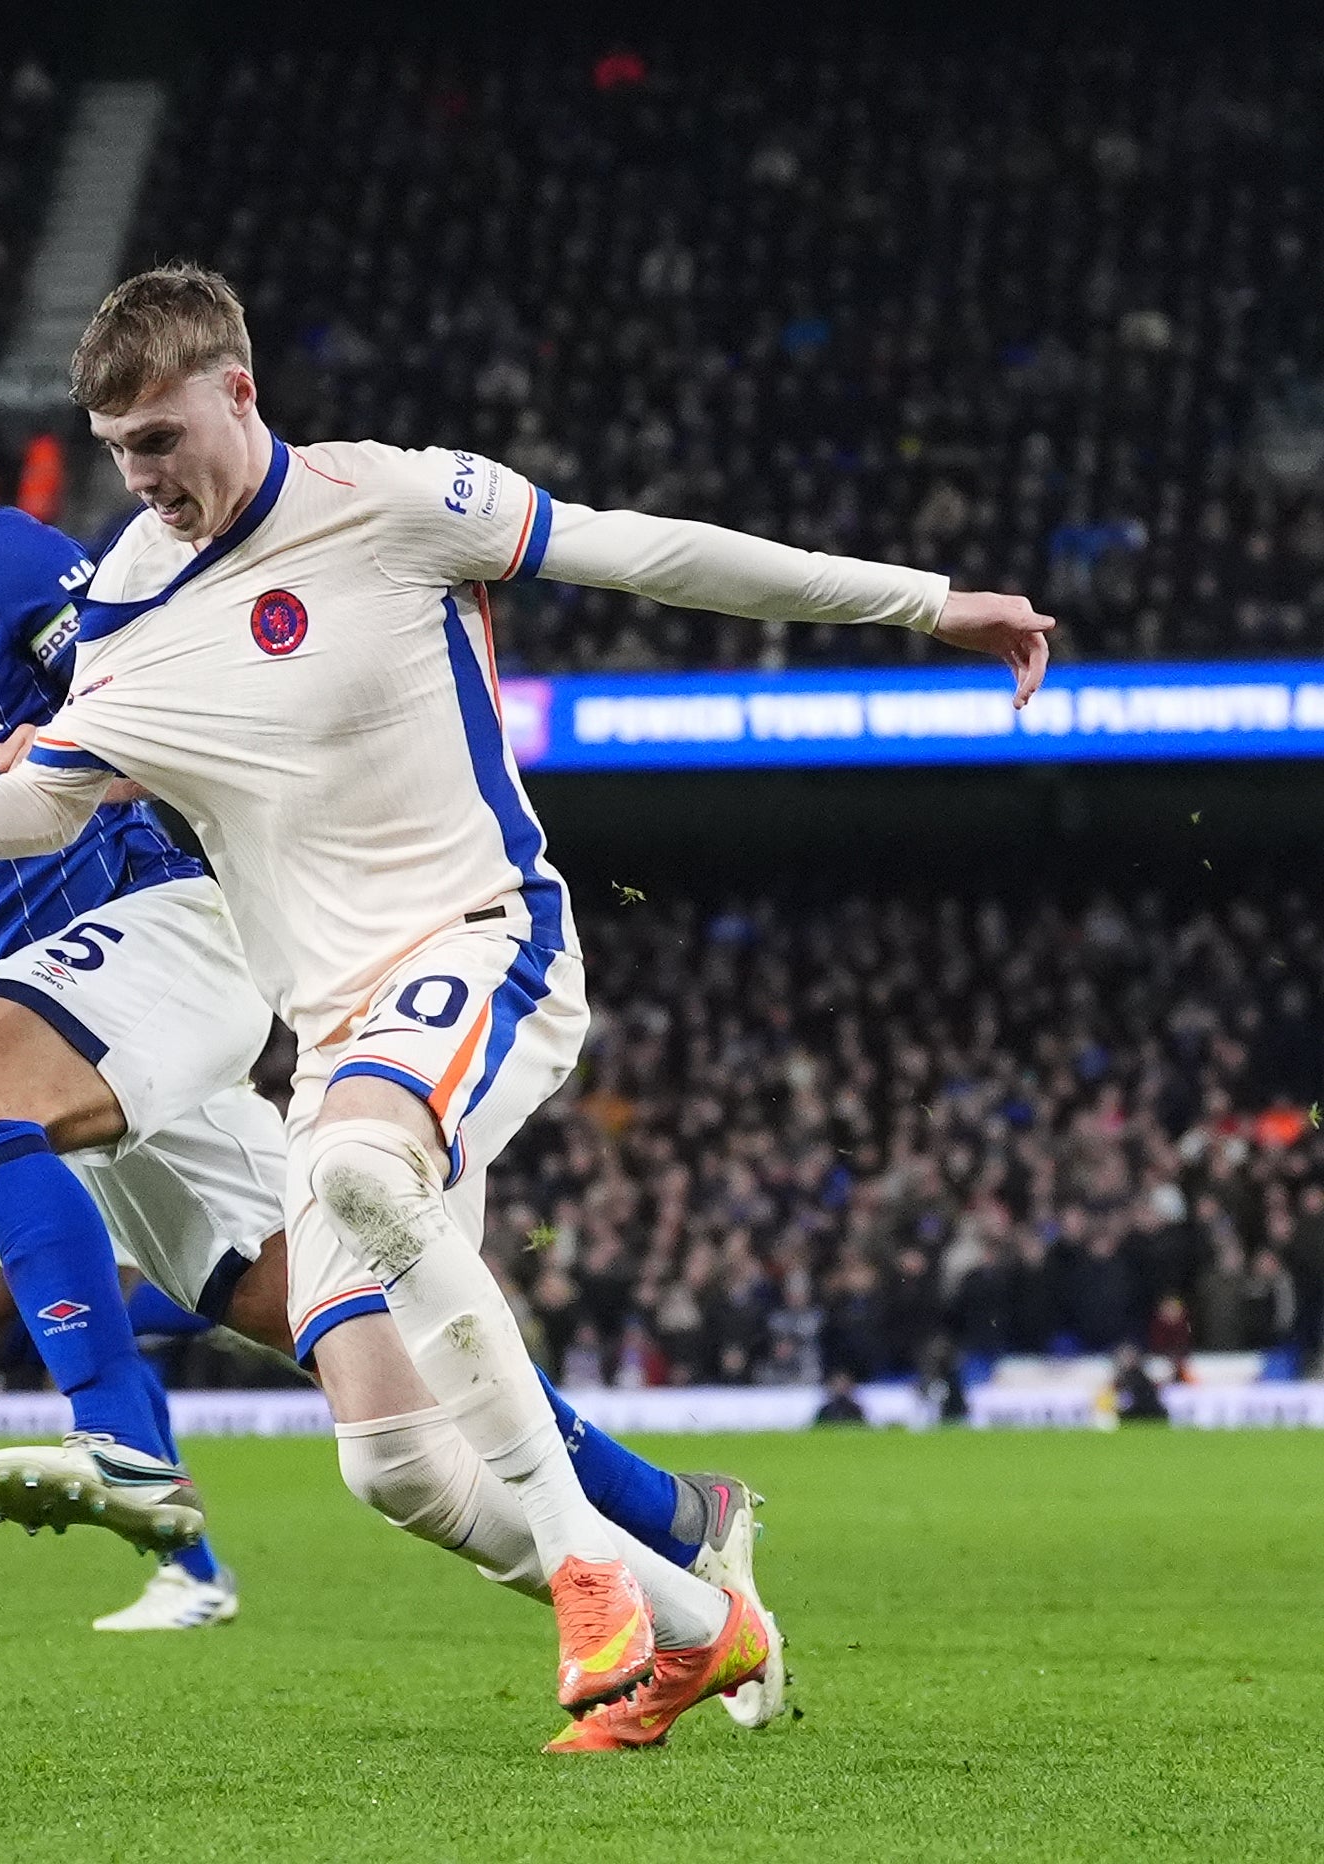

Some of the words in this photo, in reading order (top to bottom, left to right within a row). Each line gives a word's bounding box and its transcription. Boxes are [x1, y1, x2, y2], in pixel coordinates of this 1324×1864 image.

[44, 921, 125, 972] 5
[30, 969, 65, 991] umbro
[43, 1321, 88, 1337] umbro
